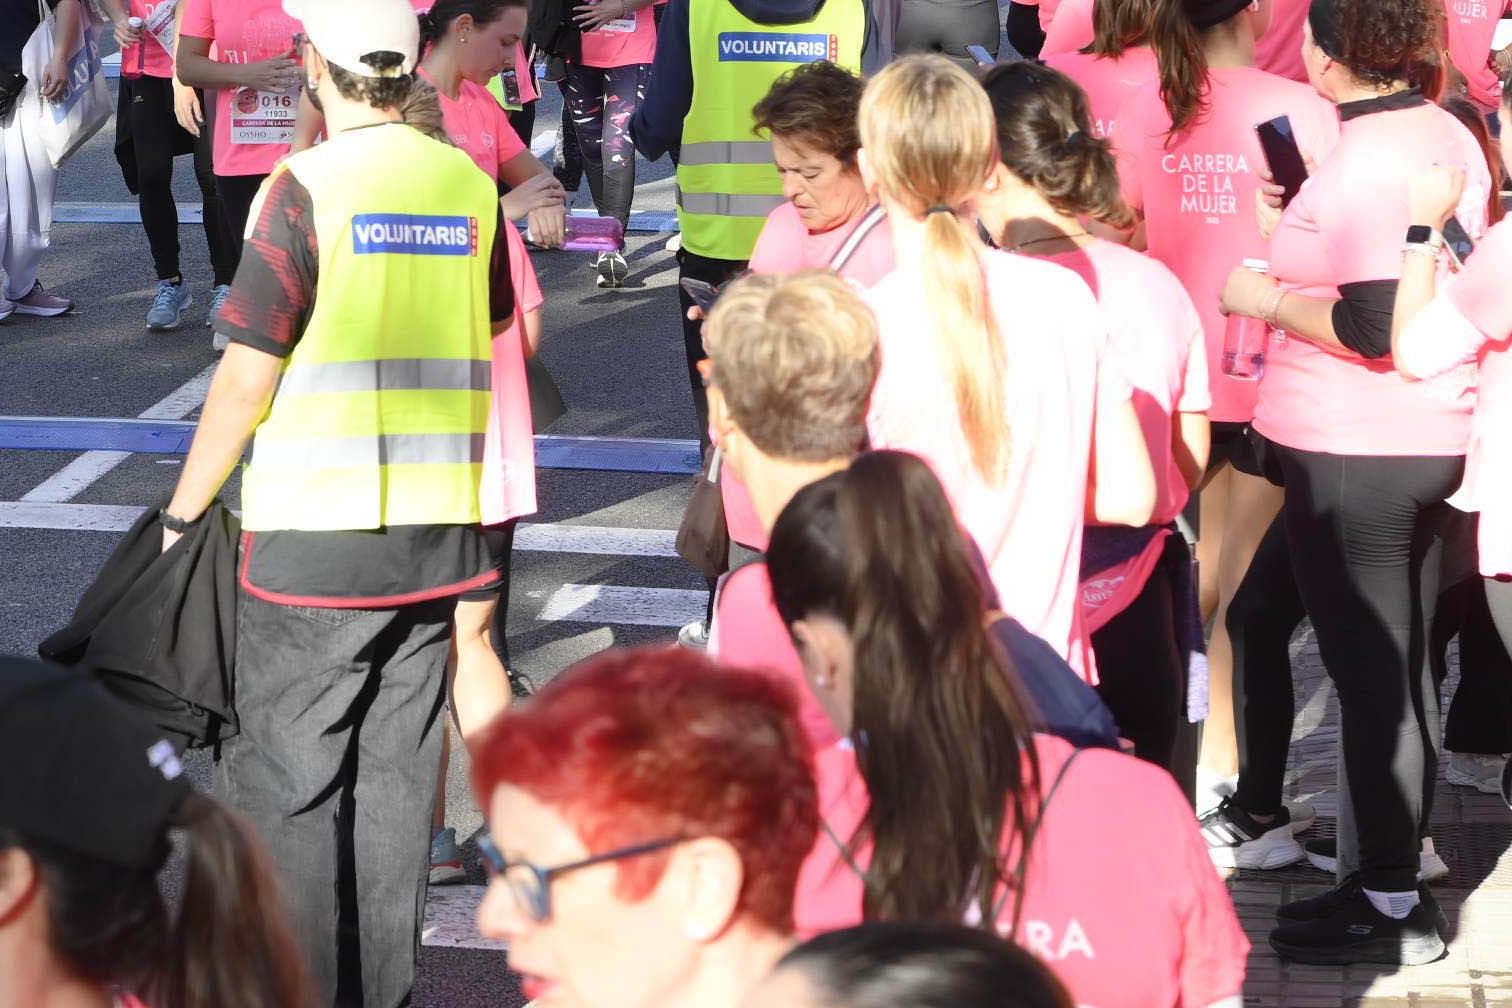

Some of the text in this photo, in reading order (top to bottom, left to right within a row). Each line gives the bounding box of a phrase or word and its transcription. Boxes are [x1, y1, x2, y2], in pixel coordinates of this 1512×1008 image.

[721, 39, 826, 57] VOLUNTARIS
[261, 95, 292, 107] 016
[264, 110, 289, 118] 11933
[1161, 153, 1251, 175] CARRERA
[1183, 174, 1234, 194] DE LA
[1179, 194, 1238, 214] MUJER
[354, 223, 469, 246] VOLUNTARIS
